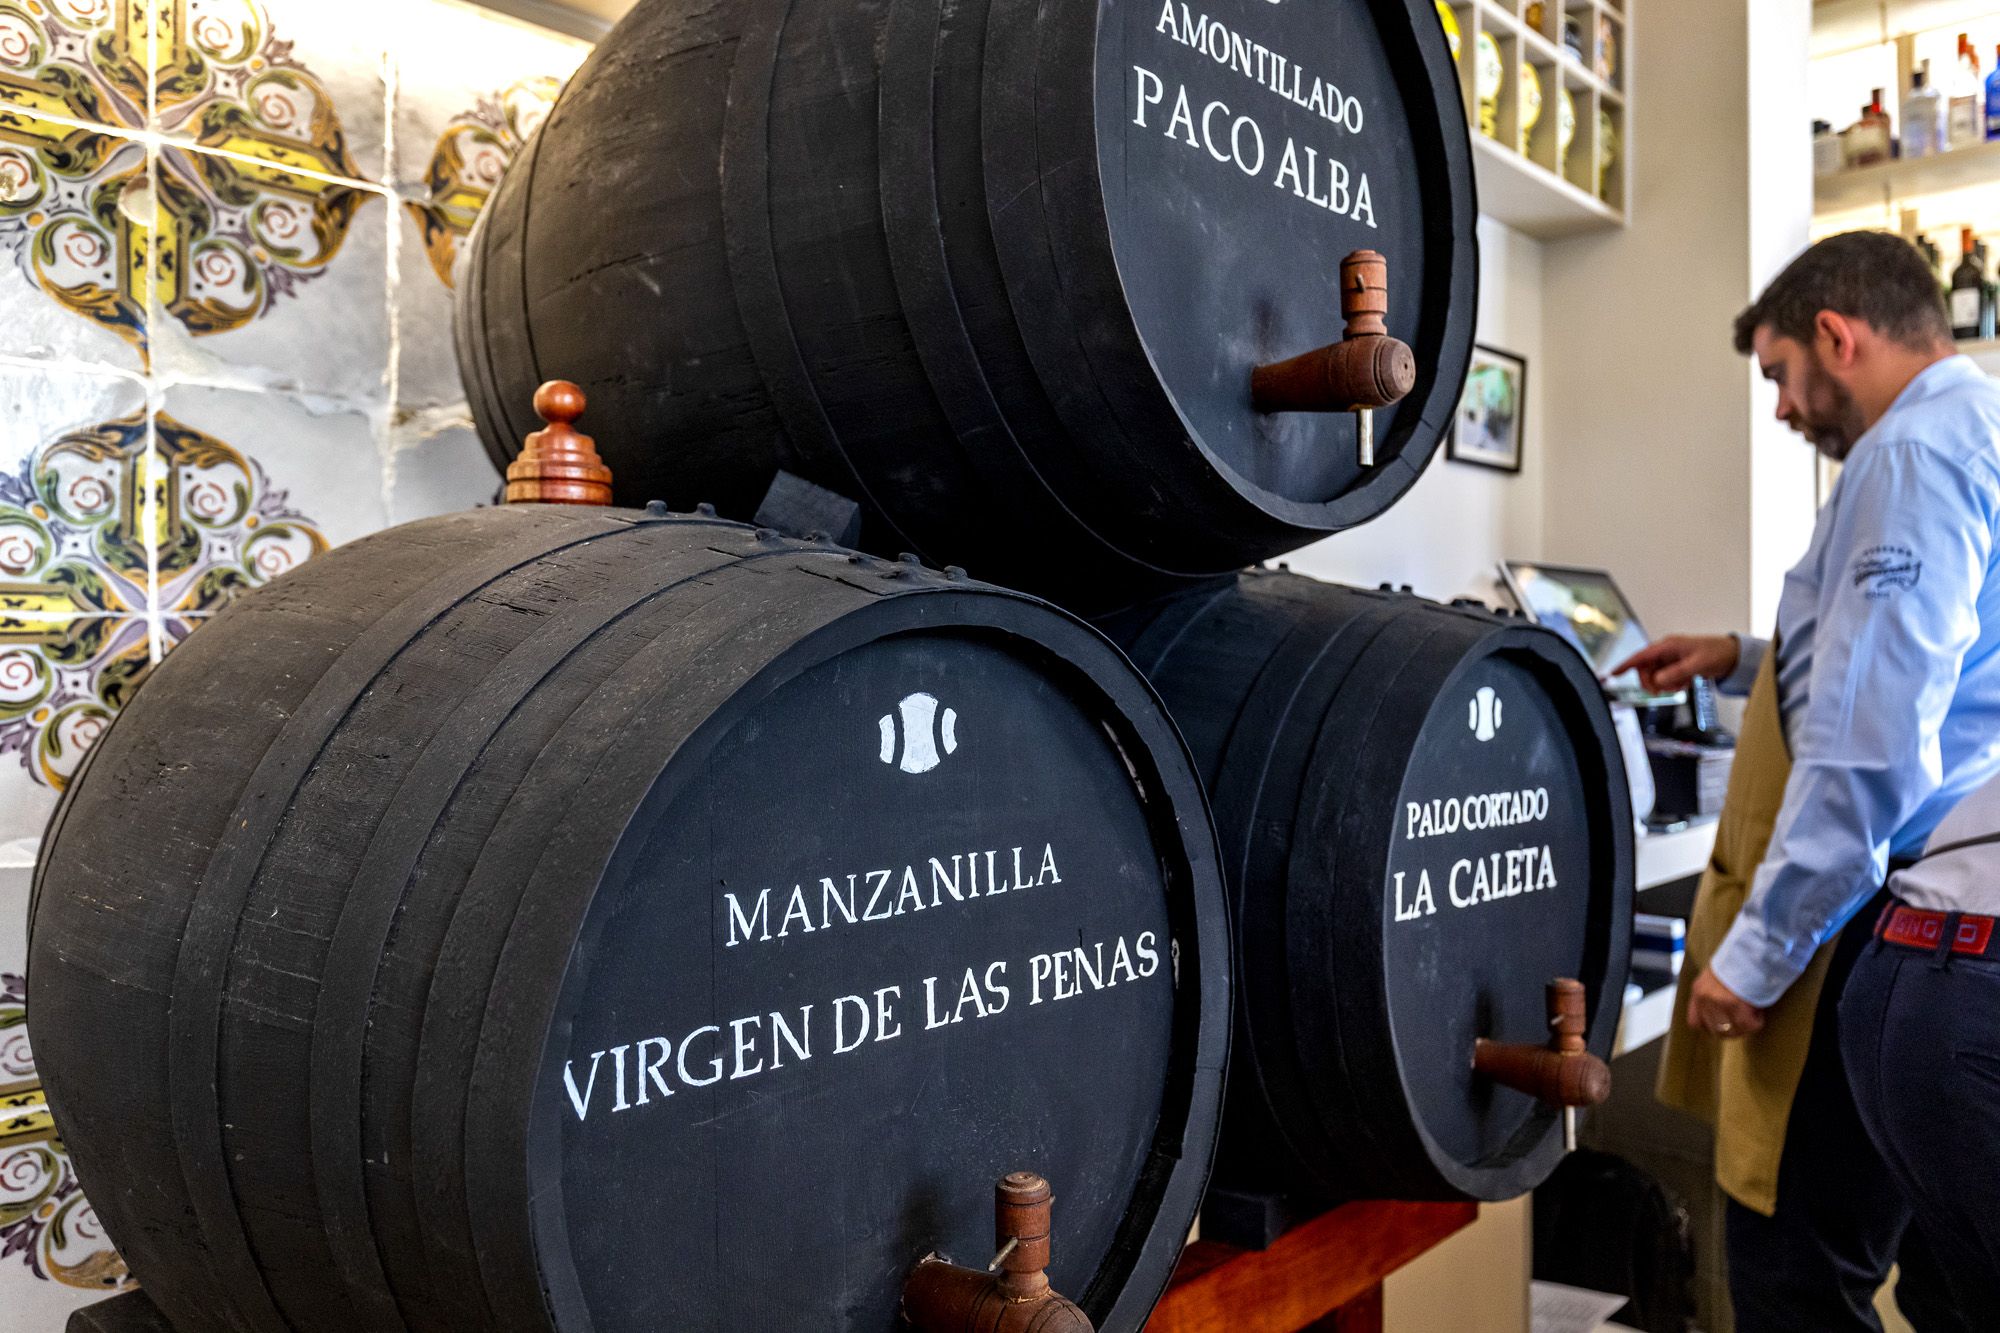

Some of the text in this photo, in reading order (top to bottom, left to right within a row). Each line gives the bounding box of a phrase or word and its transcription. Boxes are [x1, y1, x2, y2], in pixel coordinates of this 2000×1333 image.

[1156, 0, 1363, 134] AMONTILLADO
[1133, 65, 1377, 228] PACO ALBA
[1406, 787, 1549, 840] PALO CORTADO
[724, 843, 1062, 947] MANZANILLA
[1393, 844, 1557, 922] LA CALETA
[563, 931, 1159, 1122] VIRGEN DE LAS PENAS
